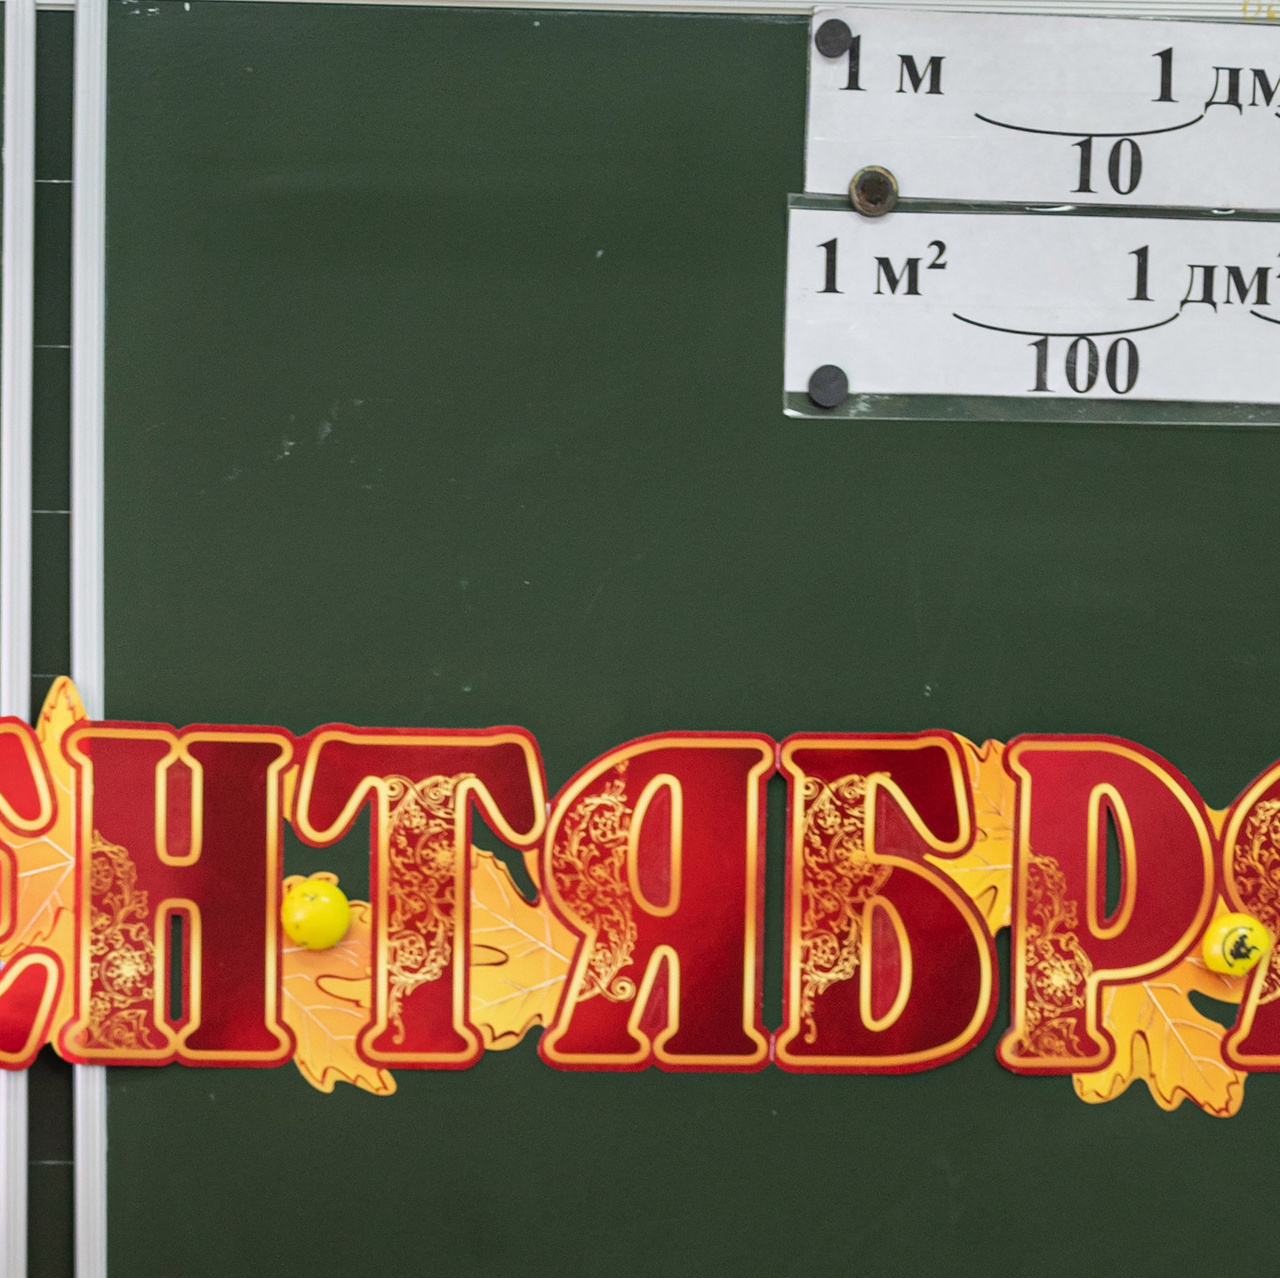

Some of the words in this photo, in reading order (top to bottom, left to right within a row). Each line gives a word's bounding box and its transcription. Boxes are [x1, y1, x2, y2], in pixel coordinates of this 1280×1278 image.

[837, 35, 866, 91] 1
[896, 54, 946, 94] м
[1151, 47, 1179, 103] 1
[1071, 136, 1142, 195] 10
[816, 238, 844, 294] 1
[1127, 245, 1155, 302] 1
[1179, 246, 1280, 313] дм
[1027, 336, 1139, 394] 100
